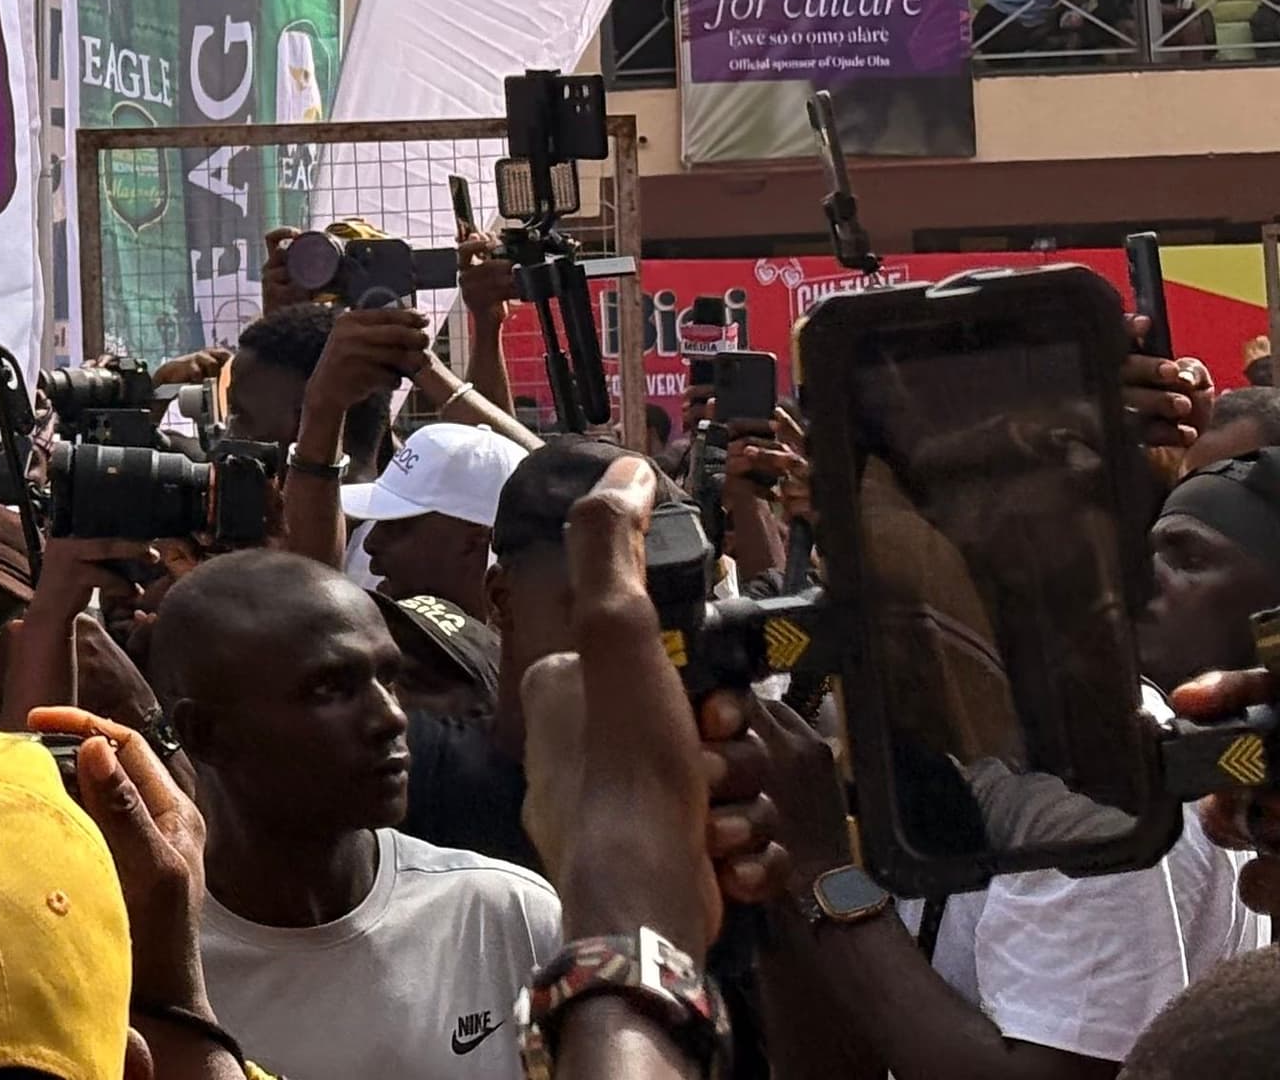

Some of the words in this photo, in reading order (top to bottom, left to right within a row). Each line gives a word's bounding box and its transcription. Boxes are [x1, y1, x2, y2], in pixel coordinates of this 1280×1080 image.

[81, 35, 174, 108] EAGLE
[645, 372, 687, 396] VERY
[458, 1010, 493, 1039] NIKE
